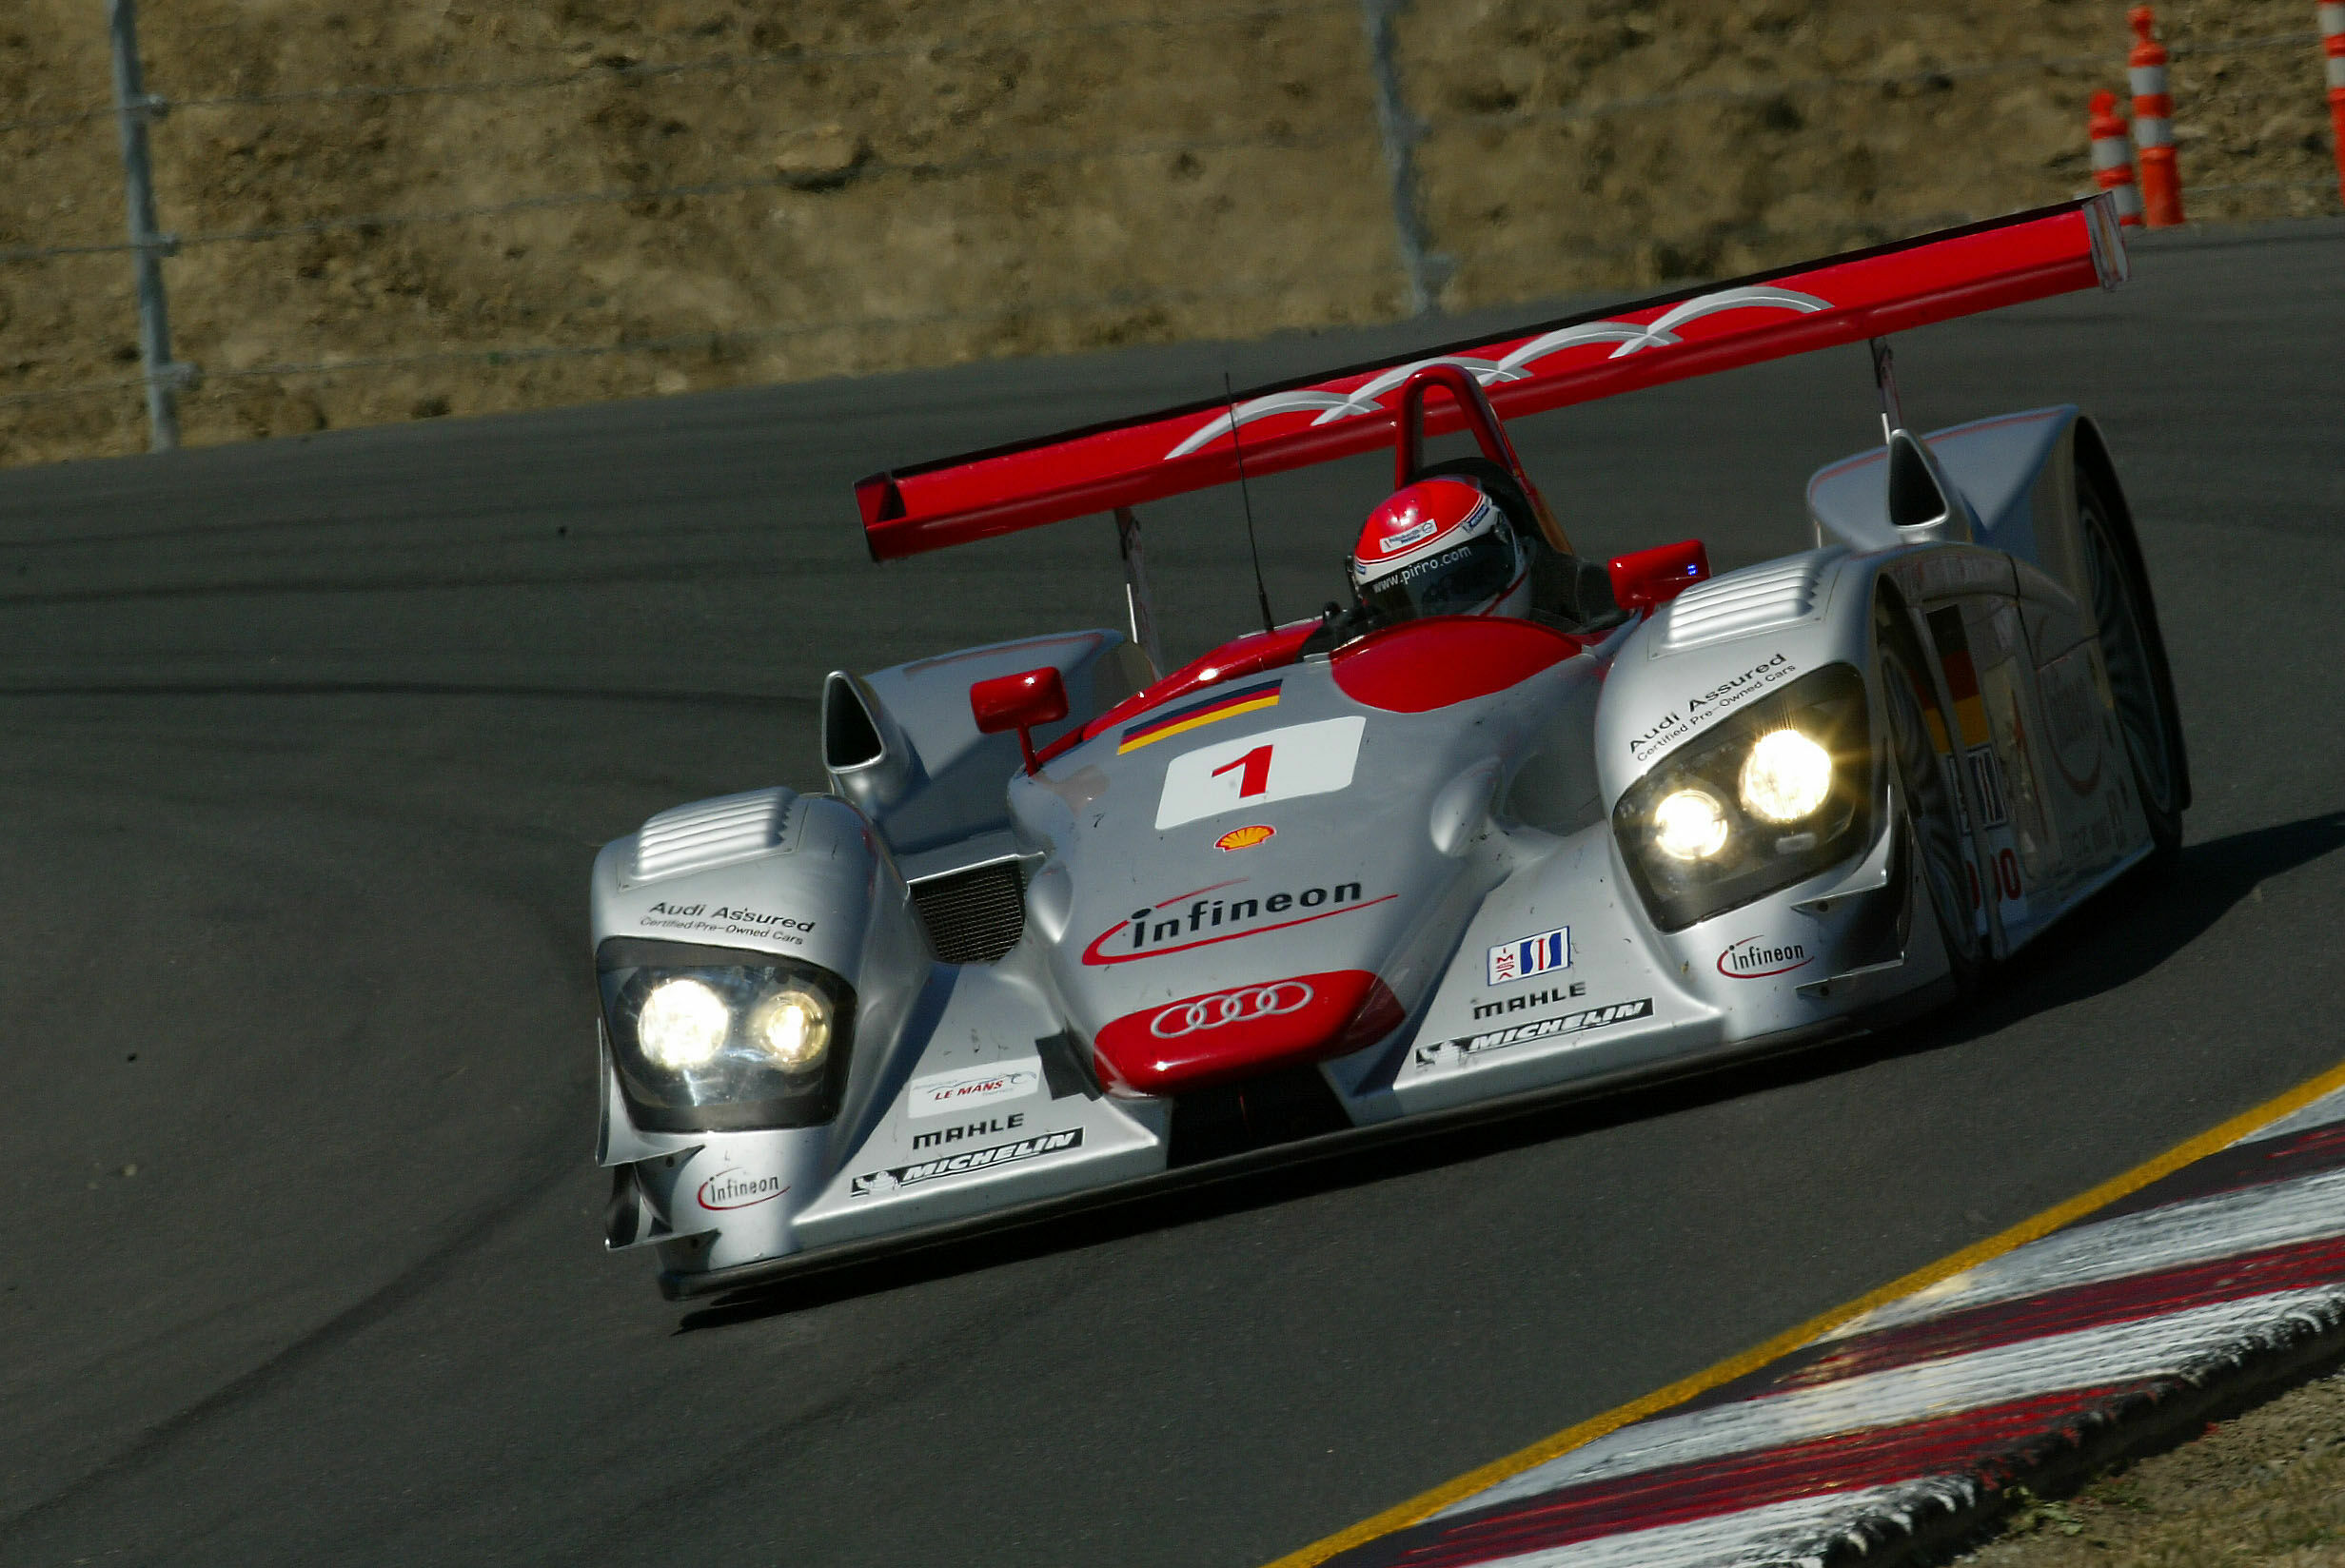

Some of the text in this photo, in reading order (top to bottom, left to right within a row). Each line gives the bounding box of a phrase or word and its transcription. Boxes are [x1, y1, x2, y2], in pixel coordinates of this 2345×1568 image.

[1372, 546, 1471, 593] www.pirro.com
[1629, 653, 1786, 754] Audi Assured
[1637, 664, 1796, 761] Certified Pre-Owned Cars
[1212, 744, 1274, 798] 1
[640, 916, 804, 945] Certified Pre-Owned Cars
[649, 902, 817, 932] Audi Assured
[1131, 881, 1362, 948] infineon
[1729, 945, 1804, 970] infineon
[1473, 982, 1586, 1020] MAHLE
[1468, 1001, 1645, 1051] MICHELIN
[935, 1088, 953, 1101] LE
[956, 1080, 1004, 1096] MANS
[913, 1113, 1025, 1150] MAHLE
[903, 1131, 1076, 1182] MICHELIN
[709, 1176, 779, 1204] infineon
